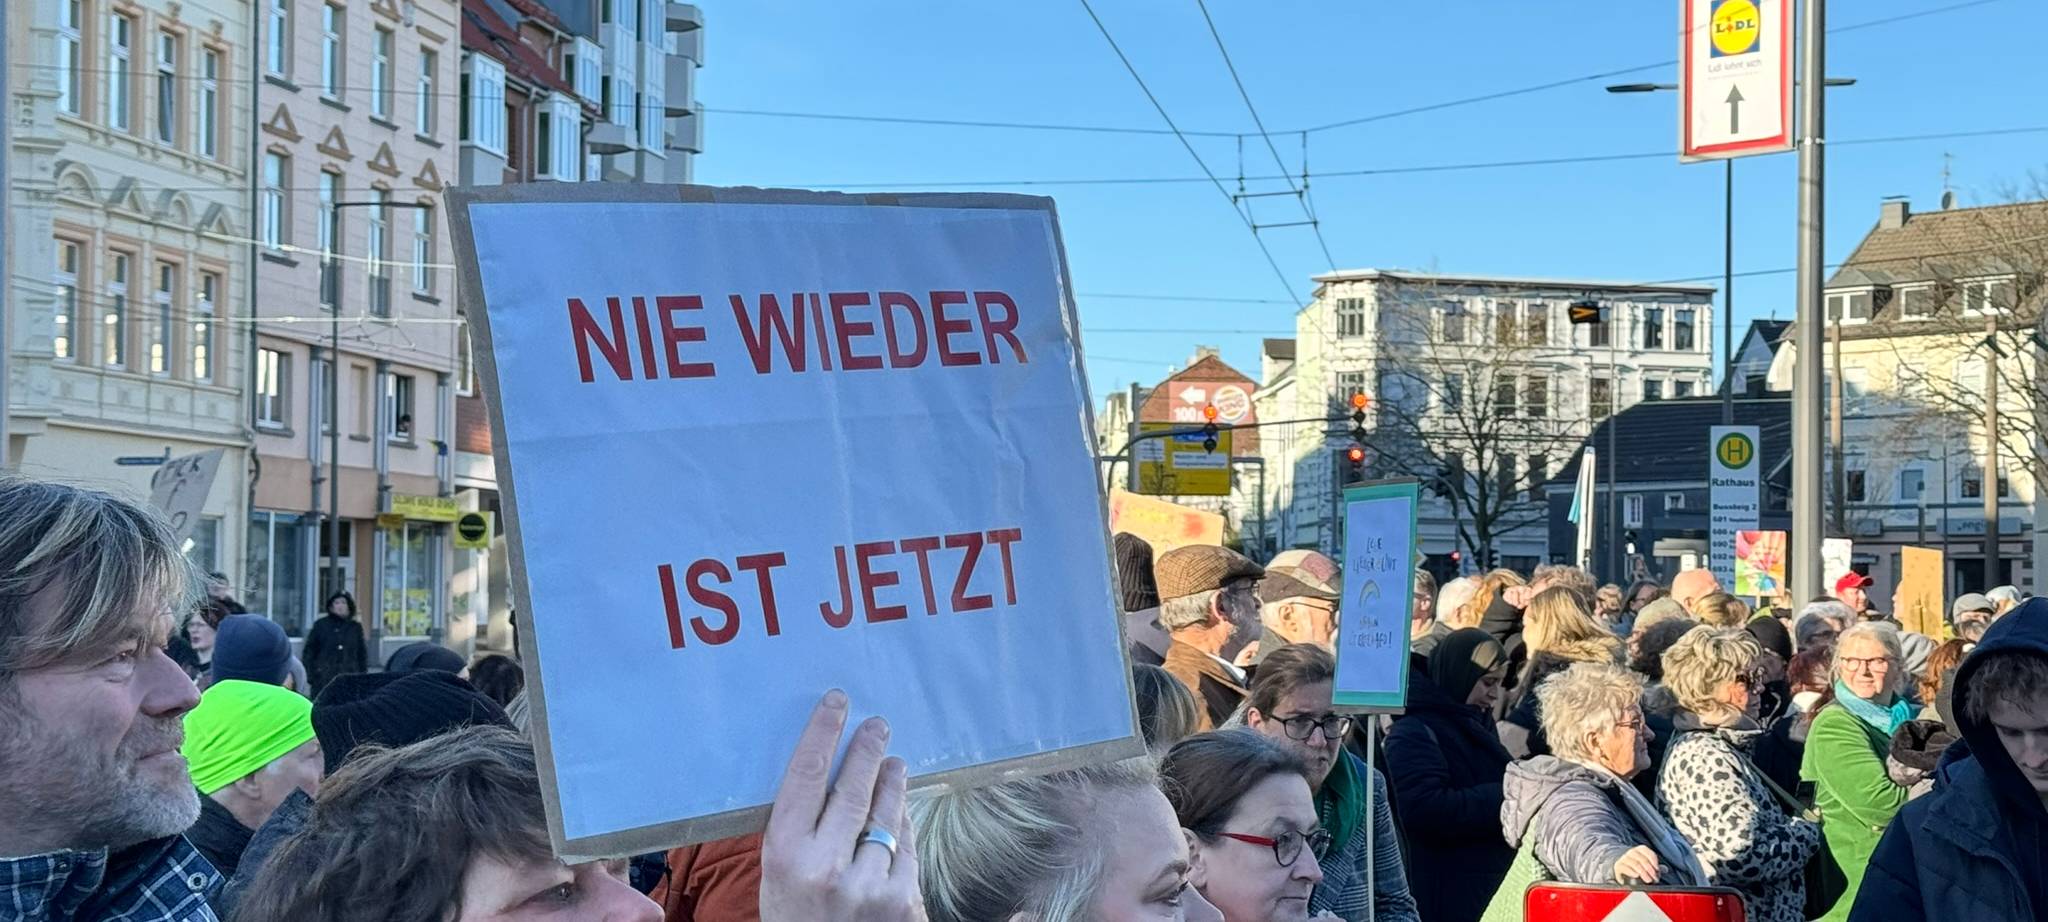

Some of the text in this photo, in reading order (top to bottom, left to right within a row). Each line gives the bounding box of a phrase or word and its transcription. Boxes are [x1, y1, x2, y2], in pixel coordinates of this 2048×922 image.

[567, 290, 1028, 383] NIE WIEDER
[1712, 478, 1755, 487] Rathaus
[1713, 503, 1750, 512] Bussteig
[657, 527, 1022, 649] IST JETZT
